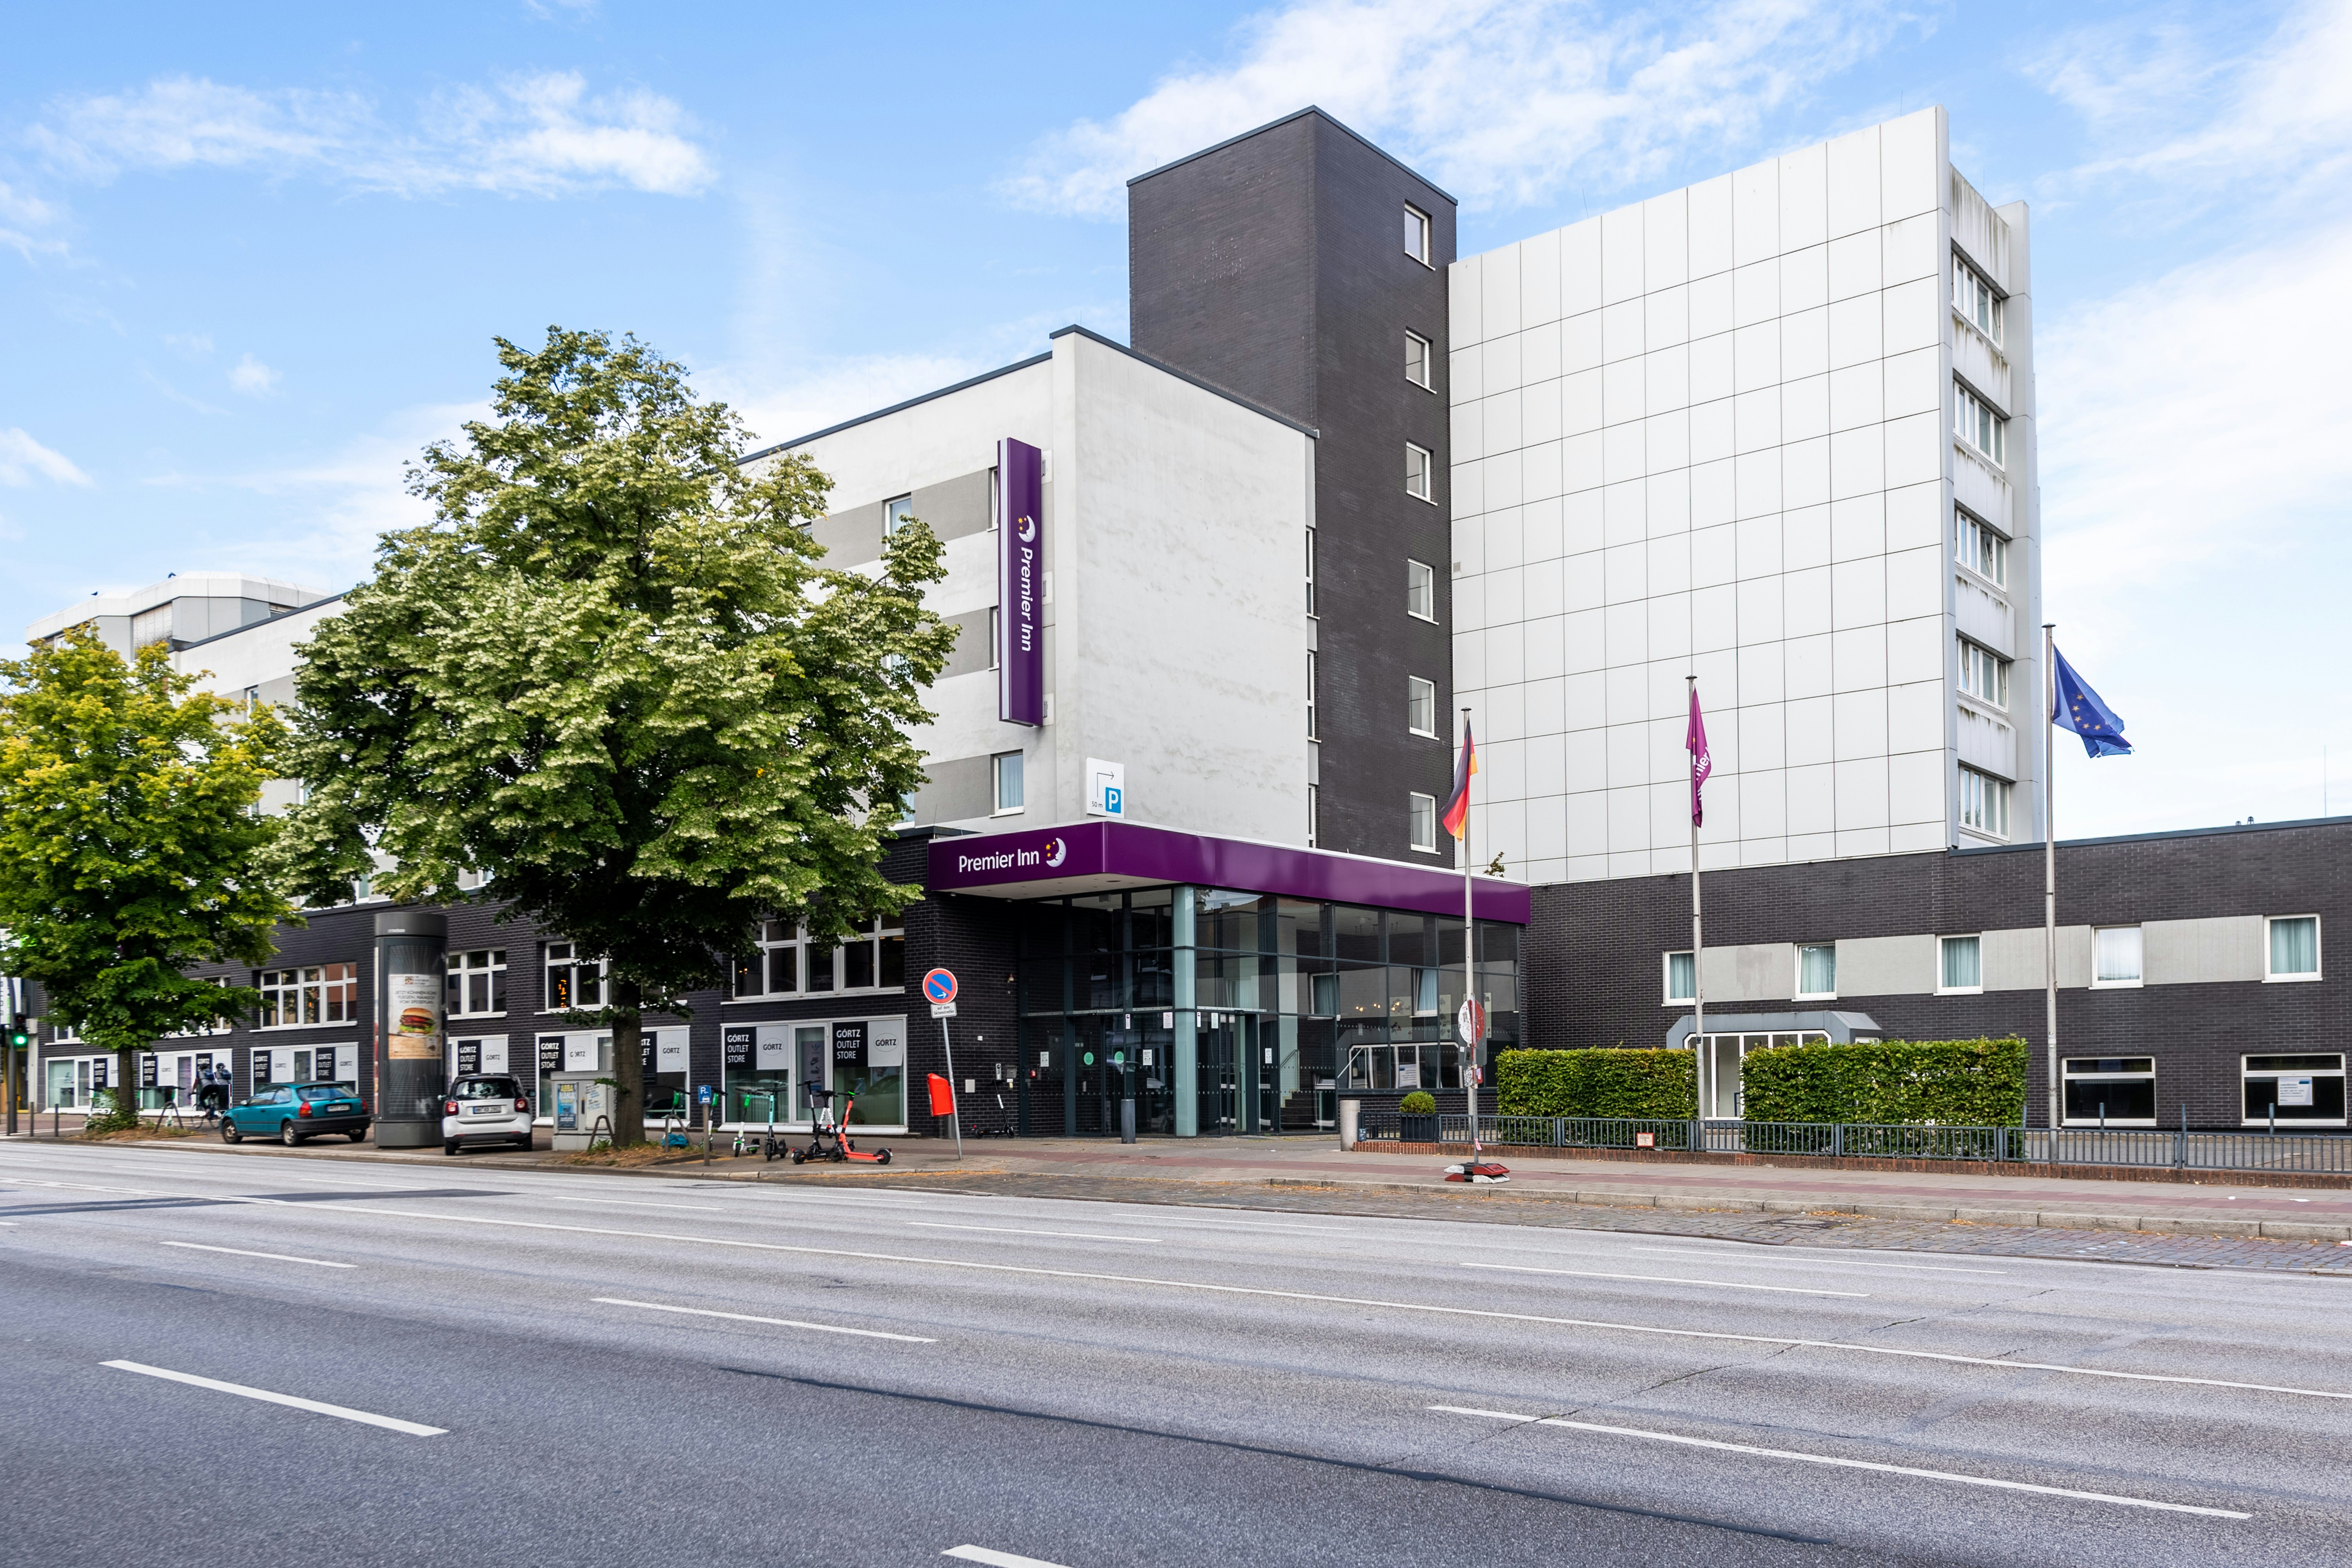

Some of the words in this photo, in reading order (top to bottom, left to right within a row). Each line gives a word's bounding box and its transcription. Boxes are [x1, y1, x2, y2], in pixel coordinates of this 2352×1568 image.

[1021, 547, 1033, 621] Premier
[1022, 623, 1033, 652] Inn
[1109, 790, 1118, 809] P
[959, 851, 1014, 873] Premier
[1018, 849, 1039, 866] Inn
[837, 1040, 860, 1049] OUTLET
